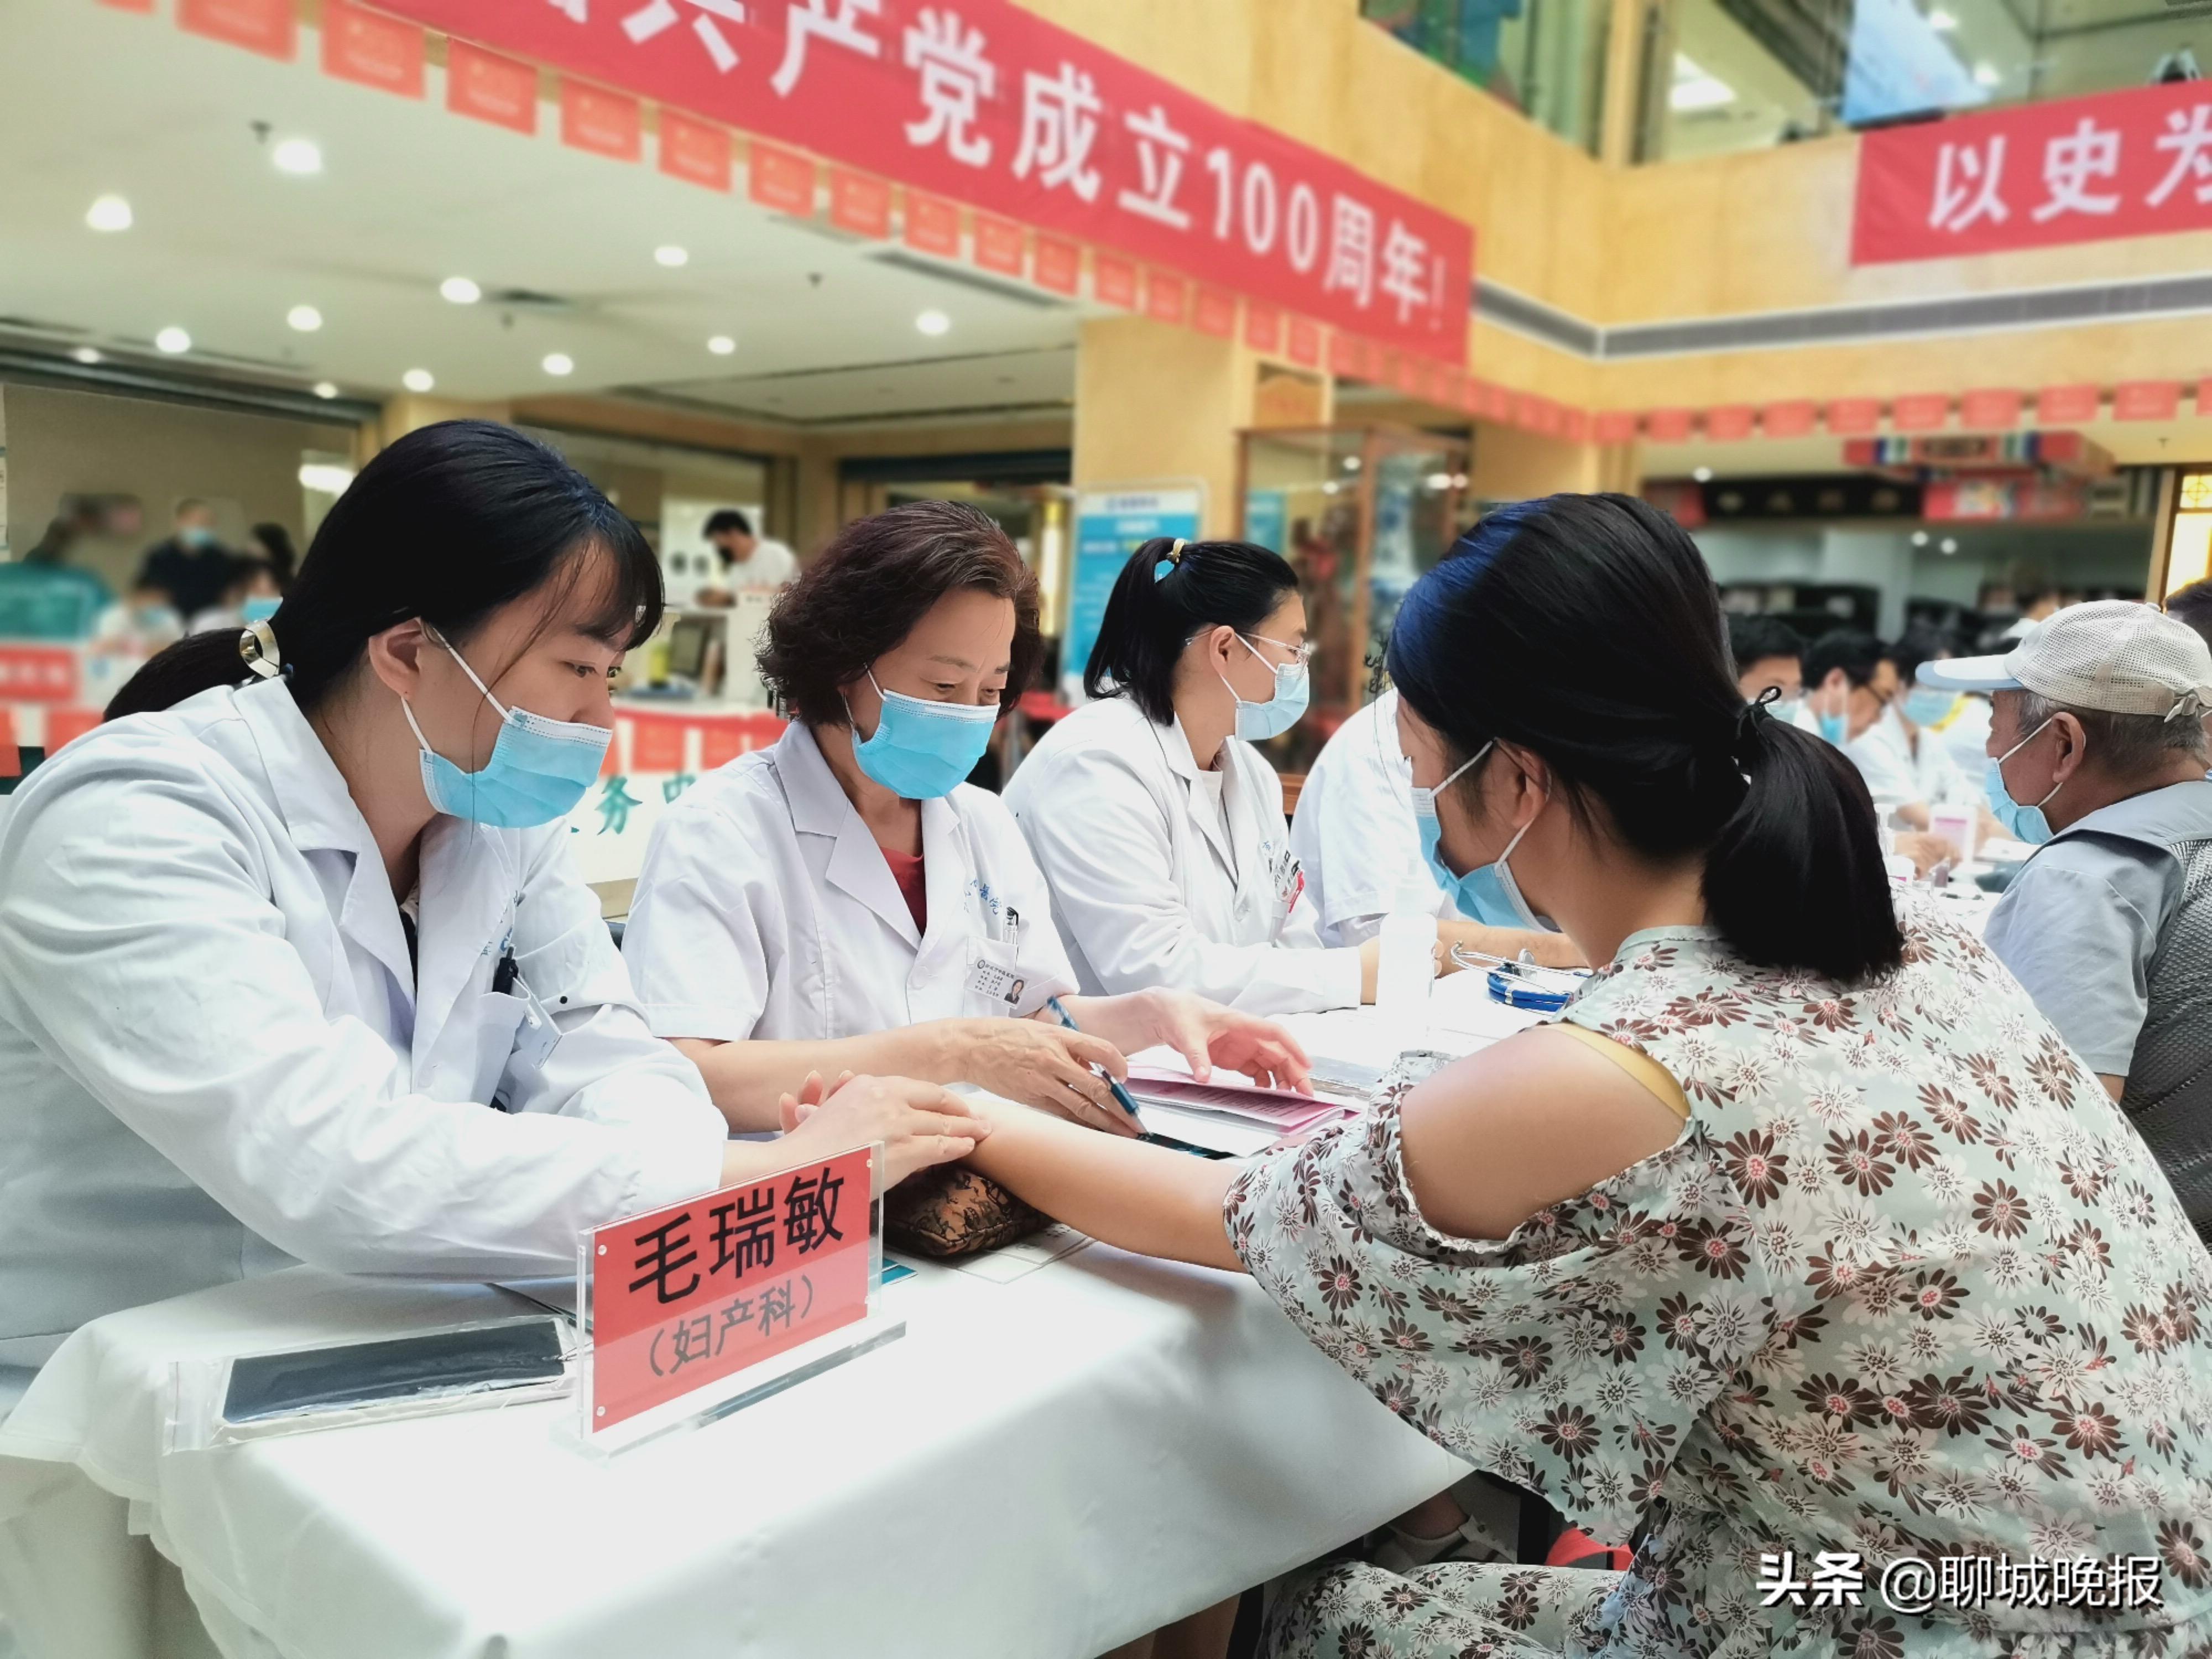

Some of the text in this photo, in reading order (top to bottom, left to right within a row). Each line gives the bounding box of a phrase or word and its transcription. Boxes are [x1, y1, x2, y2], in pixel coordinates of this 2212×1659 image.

[628, 1167, 844, 1305] 毛瑞敏
[649, 1274, 813, 1377] （妇产科）
